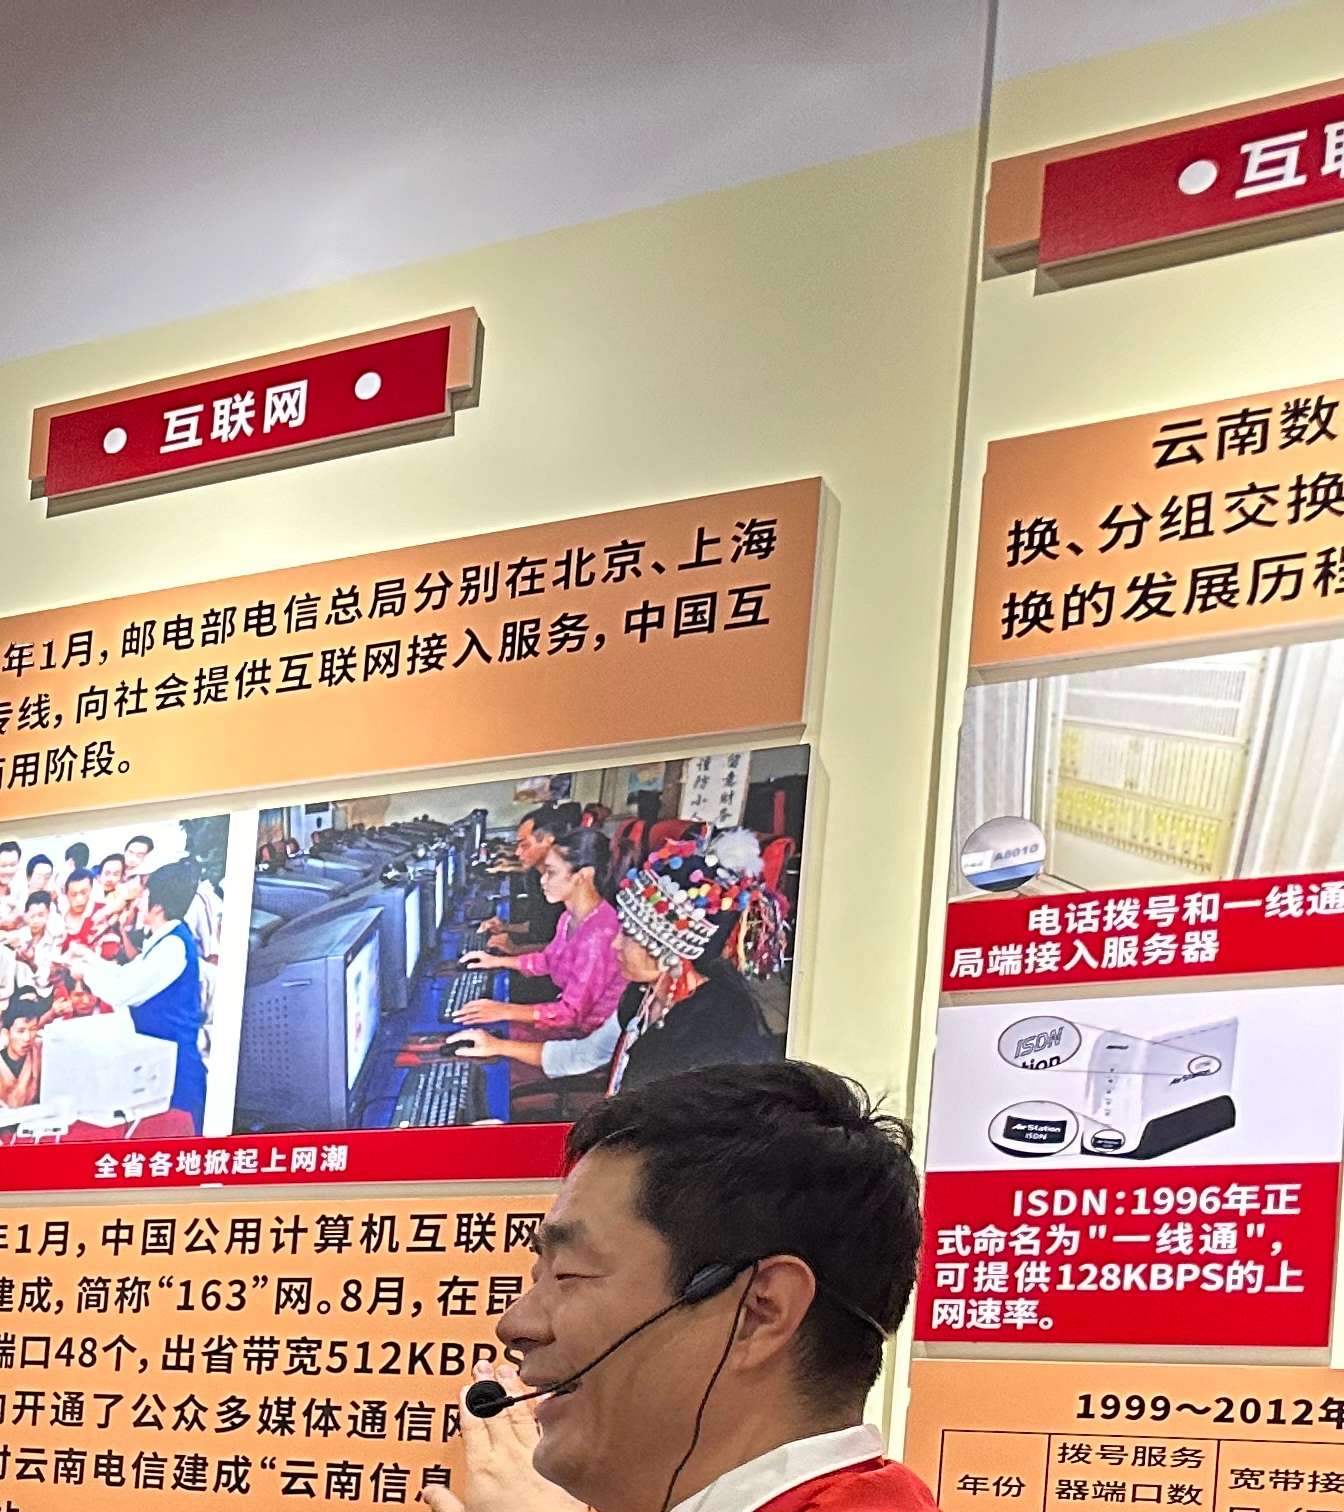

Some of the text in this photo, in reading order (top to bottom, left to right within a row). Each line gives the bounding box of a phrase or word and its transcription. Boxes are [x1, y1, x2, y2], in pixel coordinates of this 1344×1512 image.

[160, 379, 308, 454] 互联网
[1153, 395, 1340, 469] 云南数
[1006, 470, 1344, 567] 换、分组交换
[949, 929, 1219, 979] 局端接入服务器
[1014, 1026, 1065, 1059] ISDN
[94, 1145, 349, 1179] 全省各地掀起上网潮
[934, 1259, 1306, 1294] 可提供128KBPS的上
[931, 1298, 1055, 1331] 网速率。
[1057, 1442, 1206, 1469] 拨号服务
[957, 1474, 1026, 1498] 年份
[1055, 1479, 1203, 1506] 器端口数
